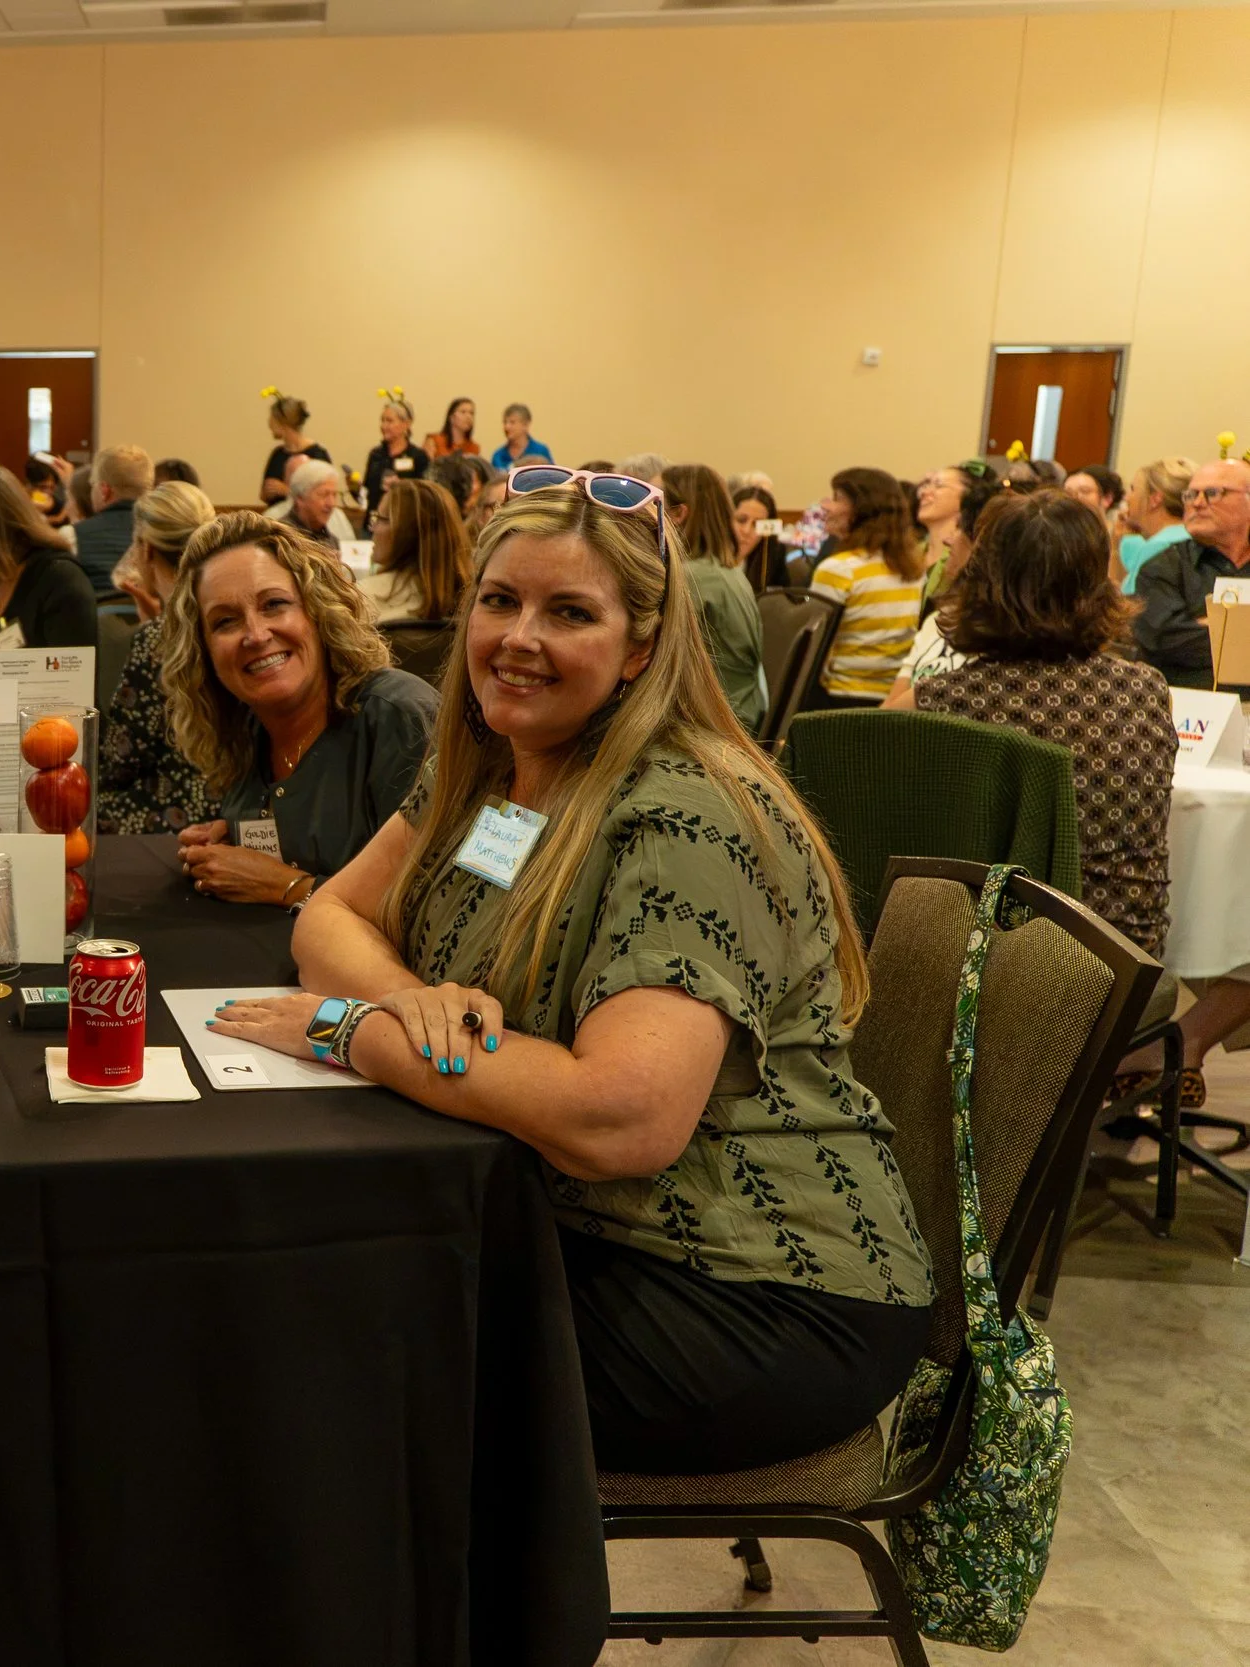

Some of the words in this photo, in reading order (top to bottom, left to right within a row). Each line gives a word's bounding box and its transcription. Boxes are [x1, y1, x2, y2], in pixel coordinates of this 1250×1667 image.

[245, 828, 276, 840] GOLDIE
[86, 1019, 124, 1028] ORIGINAL
[222, 1065, 254, 1074] 2
